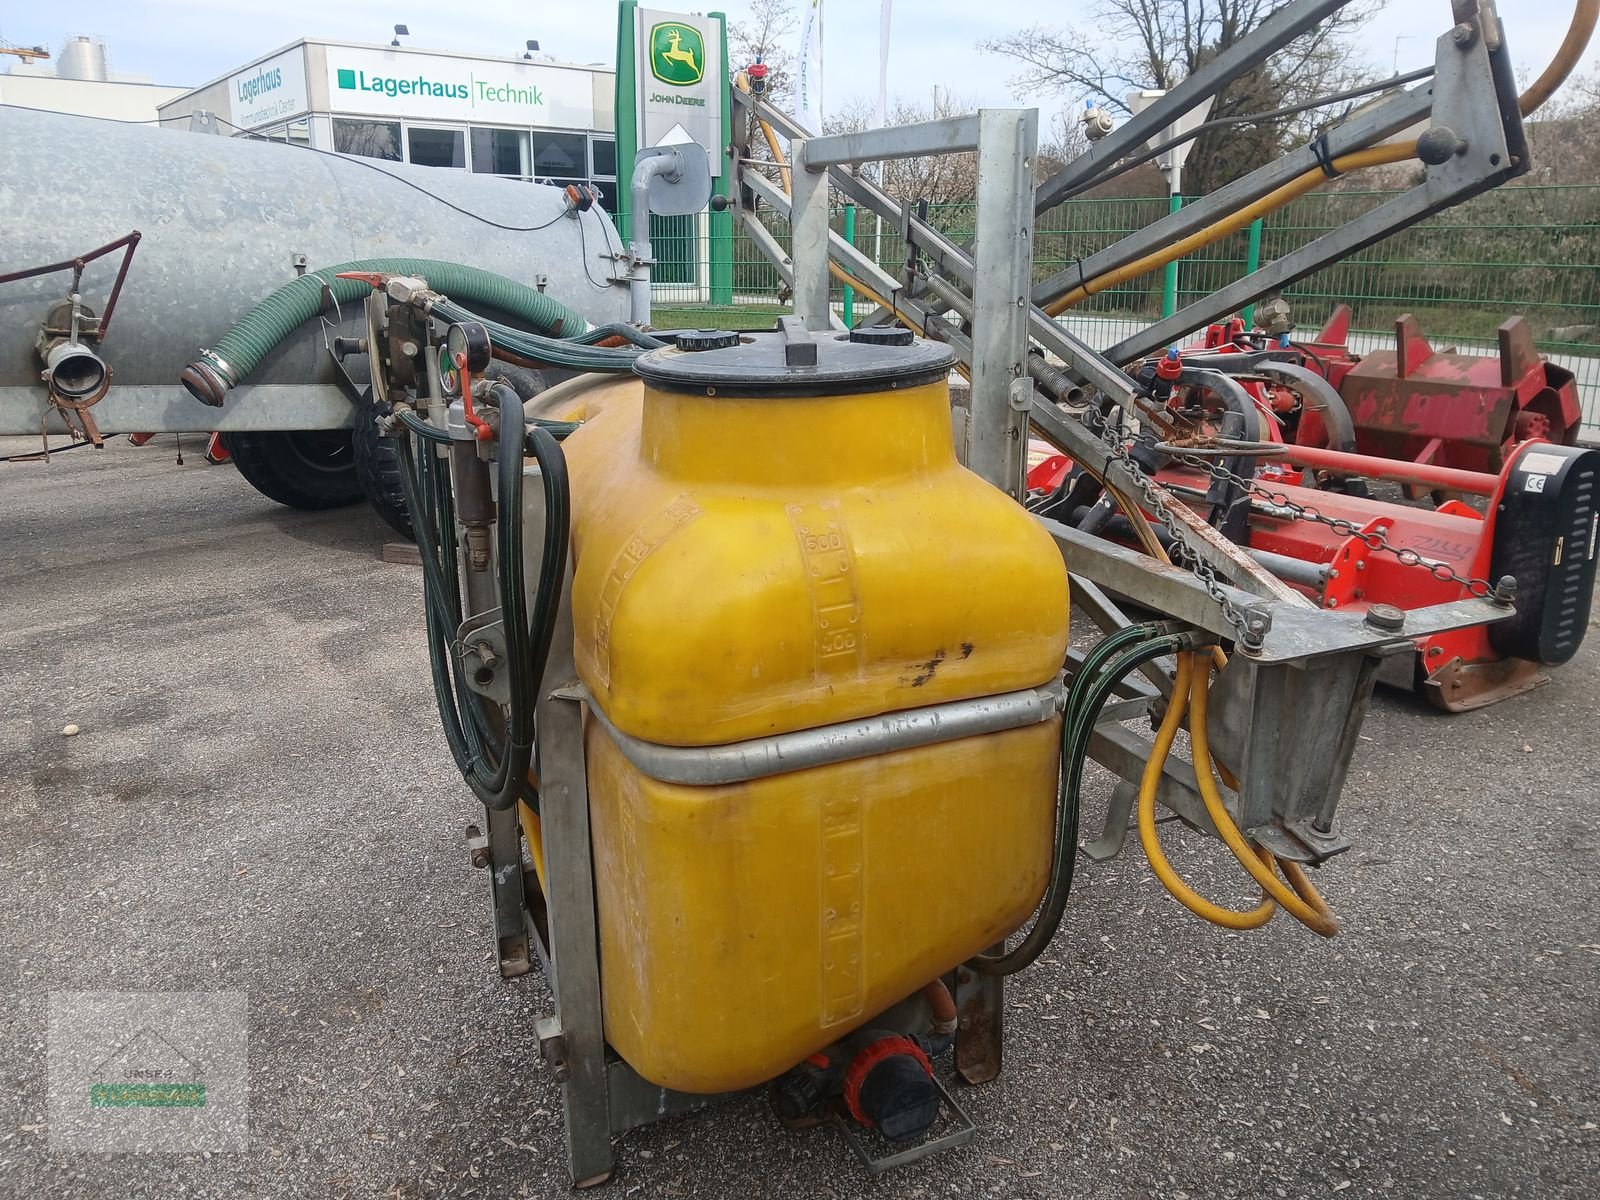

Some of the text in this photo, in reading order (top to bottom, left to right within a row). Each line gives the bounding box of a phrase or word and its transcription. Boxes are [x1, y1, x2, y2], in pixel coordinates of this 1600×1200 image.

[237, 67, 282, 105] Lagerhaus
[359, 70, 544, 106] Lagerhaus Technik
[805, 532, 842, 551] 500
